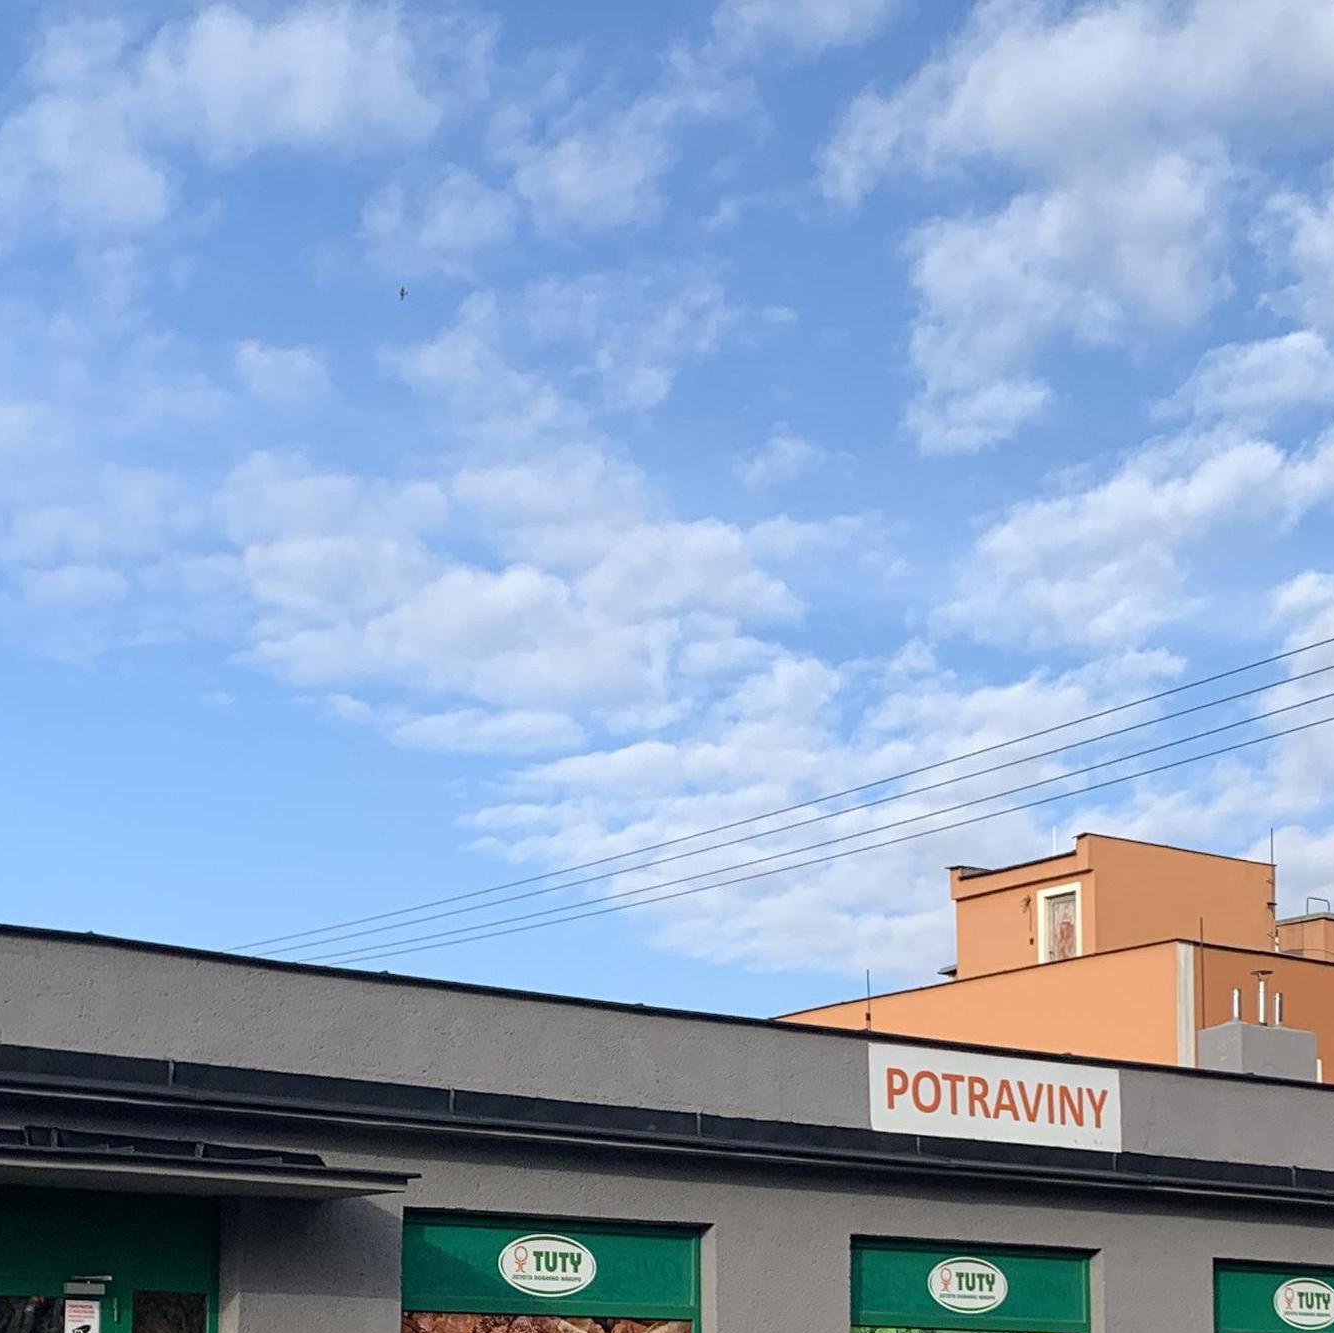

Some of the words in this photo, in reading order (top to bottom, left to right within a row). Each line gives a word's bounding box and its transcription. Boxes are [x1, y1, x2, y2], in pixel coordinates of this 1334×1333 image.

[886, 1067, 1108, 1129] POTRAVINY
[533, 1251, 582, 1273] TUTY
[955, 1271, 996, 1292] TUTY
[1297, 1291, 1331, 1310] TUTY
